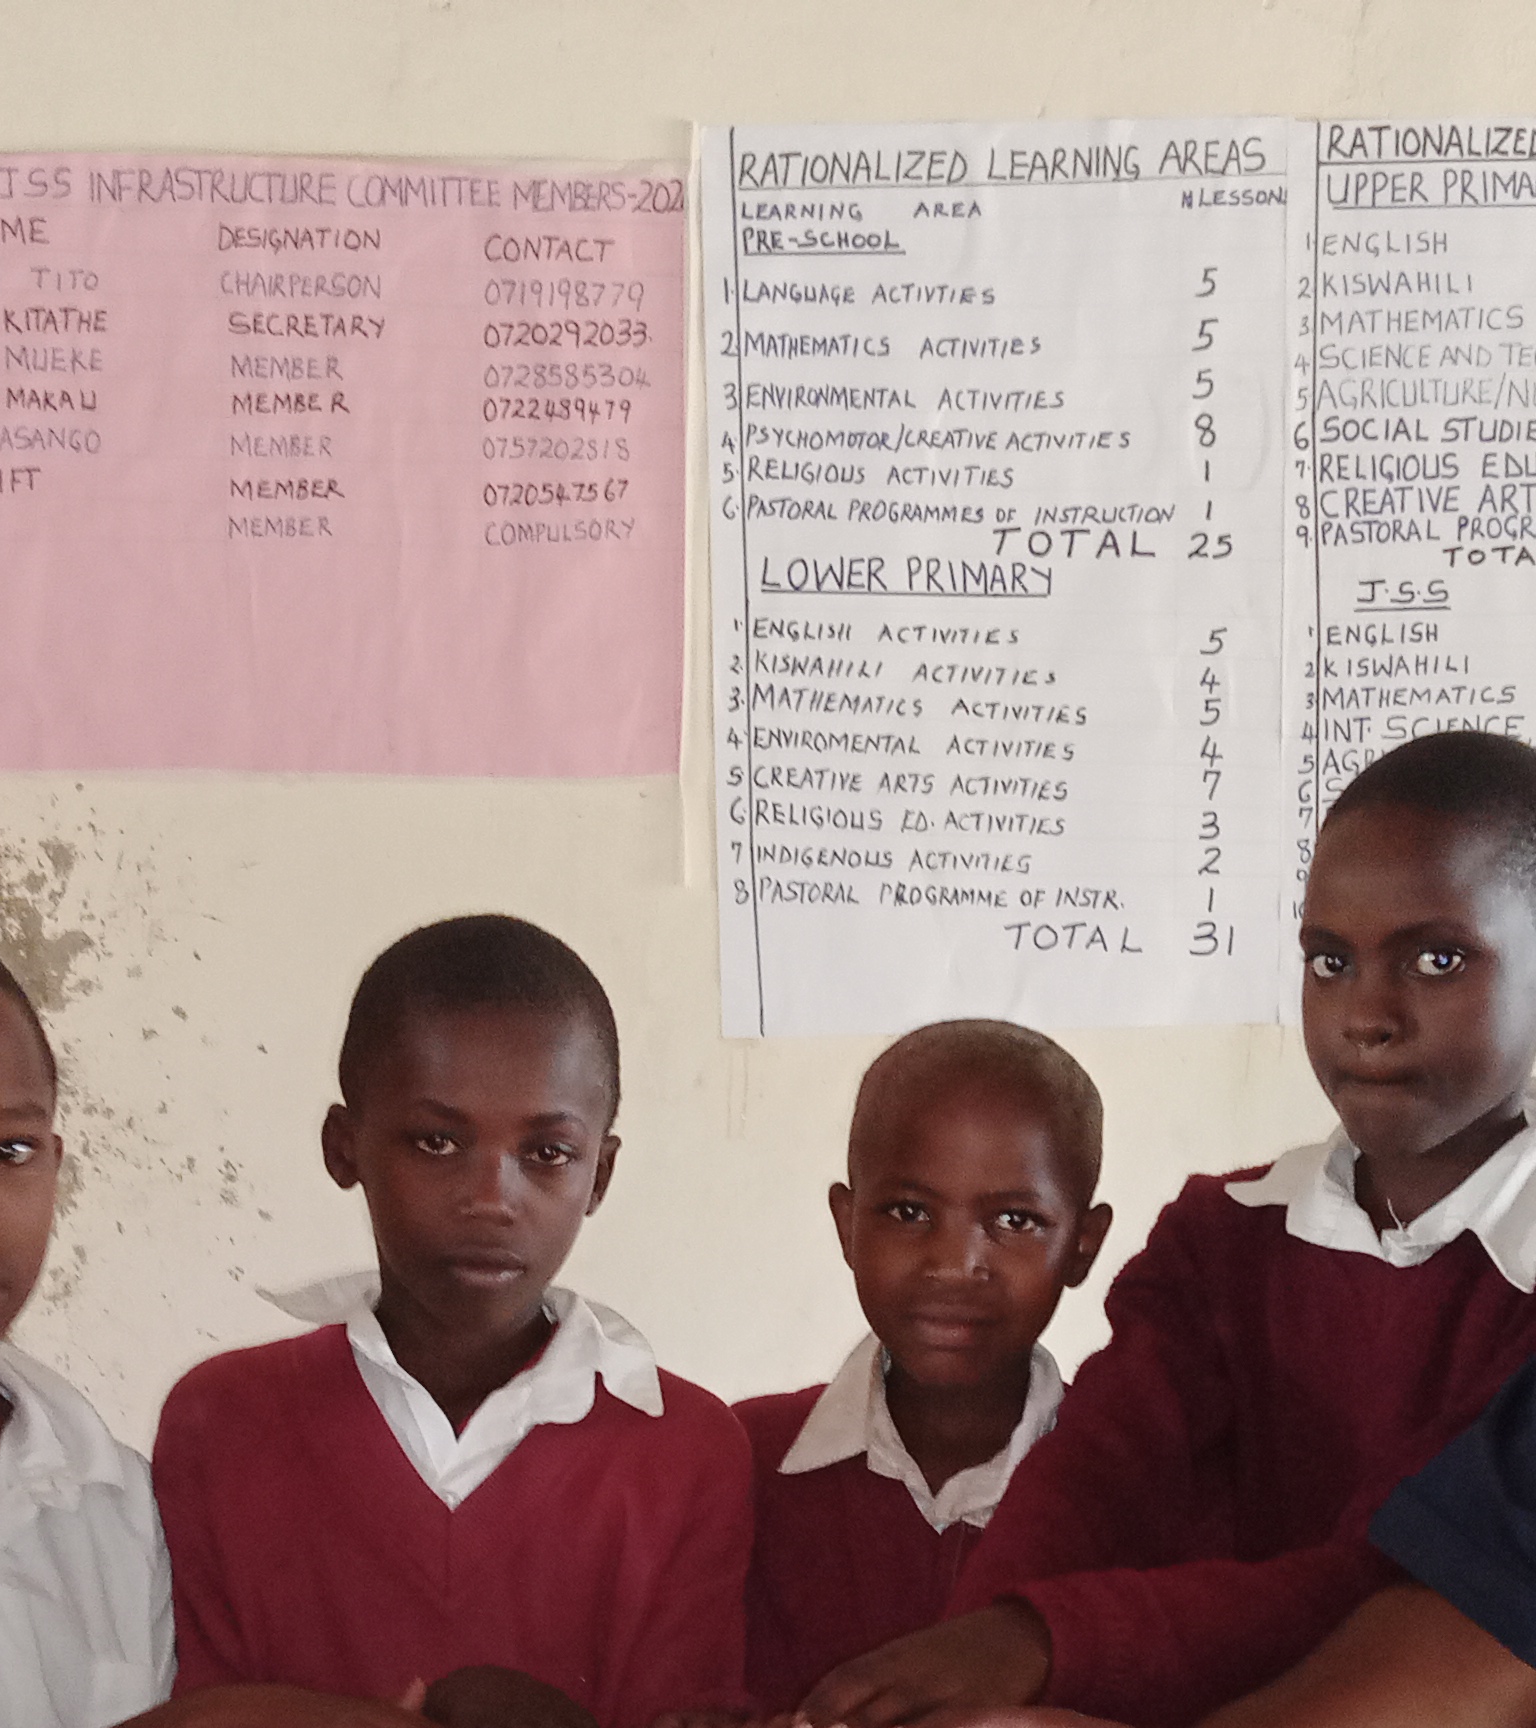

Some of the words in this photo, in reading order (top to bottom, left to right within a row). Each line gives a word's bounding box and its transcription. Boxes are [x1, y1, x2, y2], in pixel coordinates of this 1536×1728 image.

[738, 149, 968, 188] RATIONALIZED
[987, 145, 1140, 183] LEARNING
[1159, 136, 1266, 176] AREAS
[89, 166, 336, 206] INFRASTRUCTURE
[347, 174, 501, 208] COMMITTEE
[1327, 170, 1429, 208] UPPER
[741, 201, 863, 222] LEARNING
[913, 199, 983, 220] AREA
[218, 221, 381, 255] DESIGNATION
[484, 233, 615, 264] CONTACT
[742, 226, 900, 253] PRE-SCHOOL
[1322, 230, 1449, 257] ENGLISH
[31, 265, 99, 292] TITO
[221, 269, 382, 299] CHAIRPERSON
[743, 278, 855, 306] LANGUAGE
[1322, 271, 1473, 298] KISWAHILI
[3, 306, 108, 335] KITATHE
[227, 311, 386, 339] SECRETARY
[1320, 303, 1525, 336] MATHEMATICS
[744, 330, 890, 360] MATHEMATICS
[1319, 343, 1430, 371] SCIENCE
[1439, 344, 1493, 368] AND
[5, 345, 104, 374] MUEKE
[231, 353, 344, 382] MEMBER
[6, 386, 97, 412] MAKAU
[746, 383, 916, 411] ENVIRONMENTAL
[938, 387, 1064, 412] ACTIVITIES
[1005, 431, 1130, 451] ACTIVITIES
[1320, 415, 1429, 443] SOCIAL
[231, 432, 332, 459] MEMBER
[747, 455, 865, 486] RELIGIOUS
[887, 464, 1014, 489] ACTIVITIES
[1319, 452, 1460, 485] RELIGIOUS
[230, 477, 345, 503] MEMBER
[1320, 485, 1461, 519] CREATIVE
[747, 494, 837, 522] PASTORAL
[848, 499, 984, 524] PROGRAMMES
[1034, 503, 1176, 526] INSTRUCTION
[228, 514, 333, 540] MEMBER
[484, 517, 636, 547] COMPULSORY
[1320, 518, 1441, 547] PASTORAL
[993, 527, 1156, 559] TOTAL
[1187, 532, 1233, 560] 25
[761, 556, 887, 592] LOWER
[907, 555, 1052, 596] PRIMARY
[753, 617, 852, 642] ENGLISH
[878, 623, 1019, 645] ACTIVITIES
[1326, 622, 1439, 648] ENGLISH
[755, 649, 883, 679] KISWAHILI
[912, 661, 1057, 687] ACTIVITIES
[1323, 653, 1469, 678] KISWAHILI
[752, 683, 924, 715] MATHEMATICS
[950, 698, 1088, 727] ACTIVITIES
[1322, 685, 1517, 711] MATHEMATICS
[753, 765, 863, 792] CREATIVE
[878, 771, 936, 796] ARTS
[754, 798, 883, 832] RELIGIOUS
[757, 843, 893, 869] INDIGENOUS
[758, 875, 860, 905] PASTORAL
[1020, 889, 1047, 909] OF
[1004, 921, 1144, 954] TOTAL
[1189, 920, 1235, 957] 31
